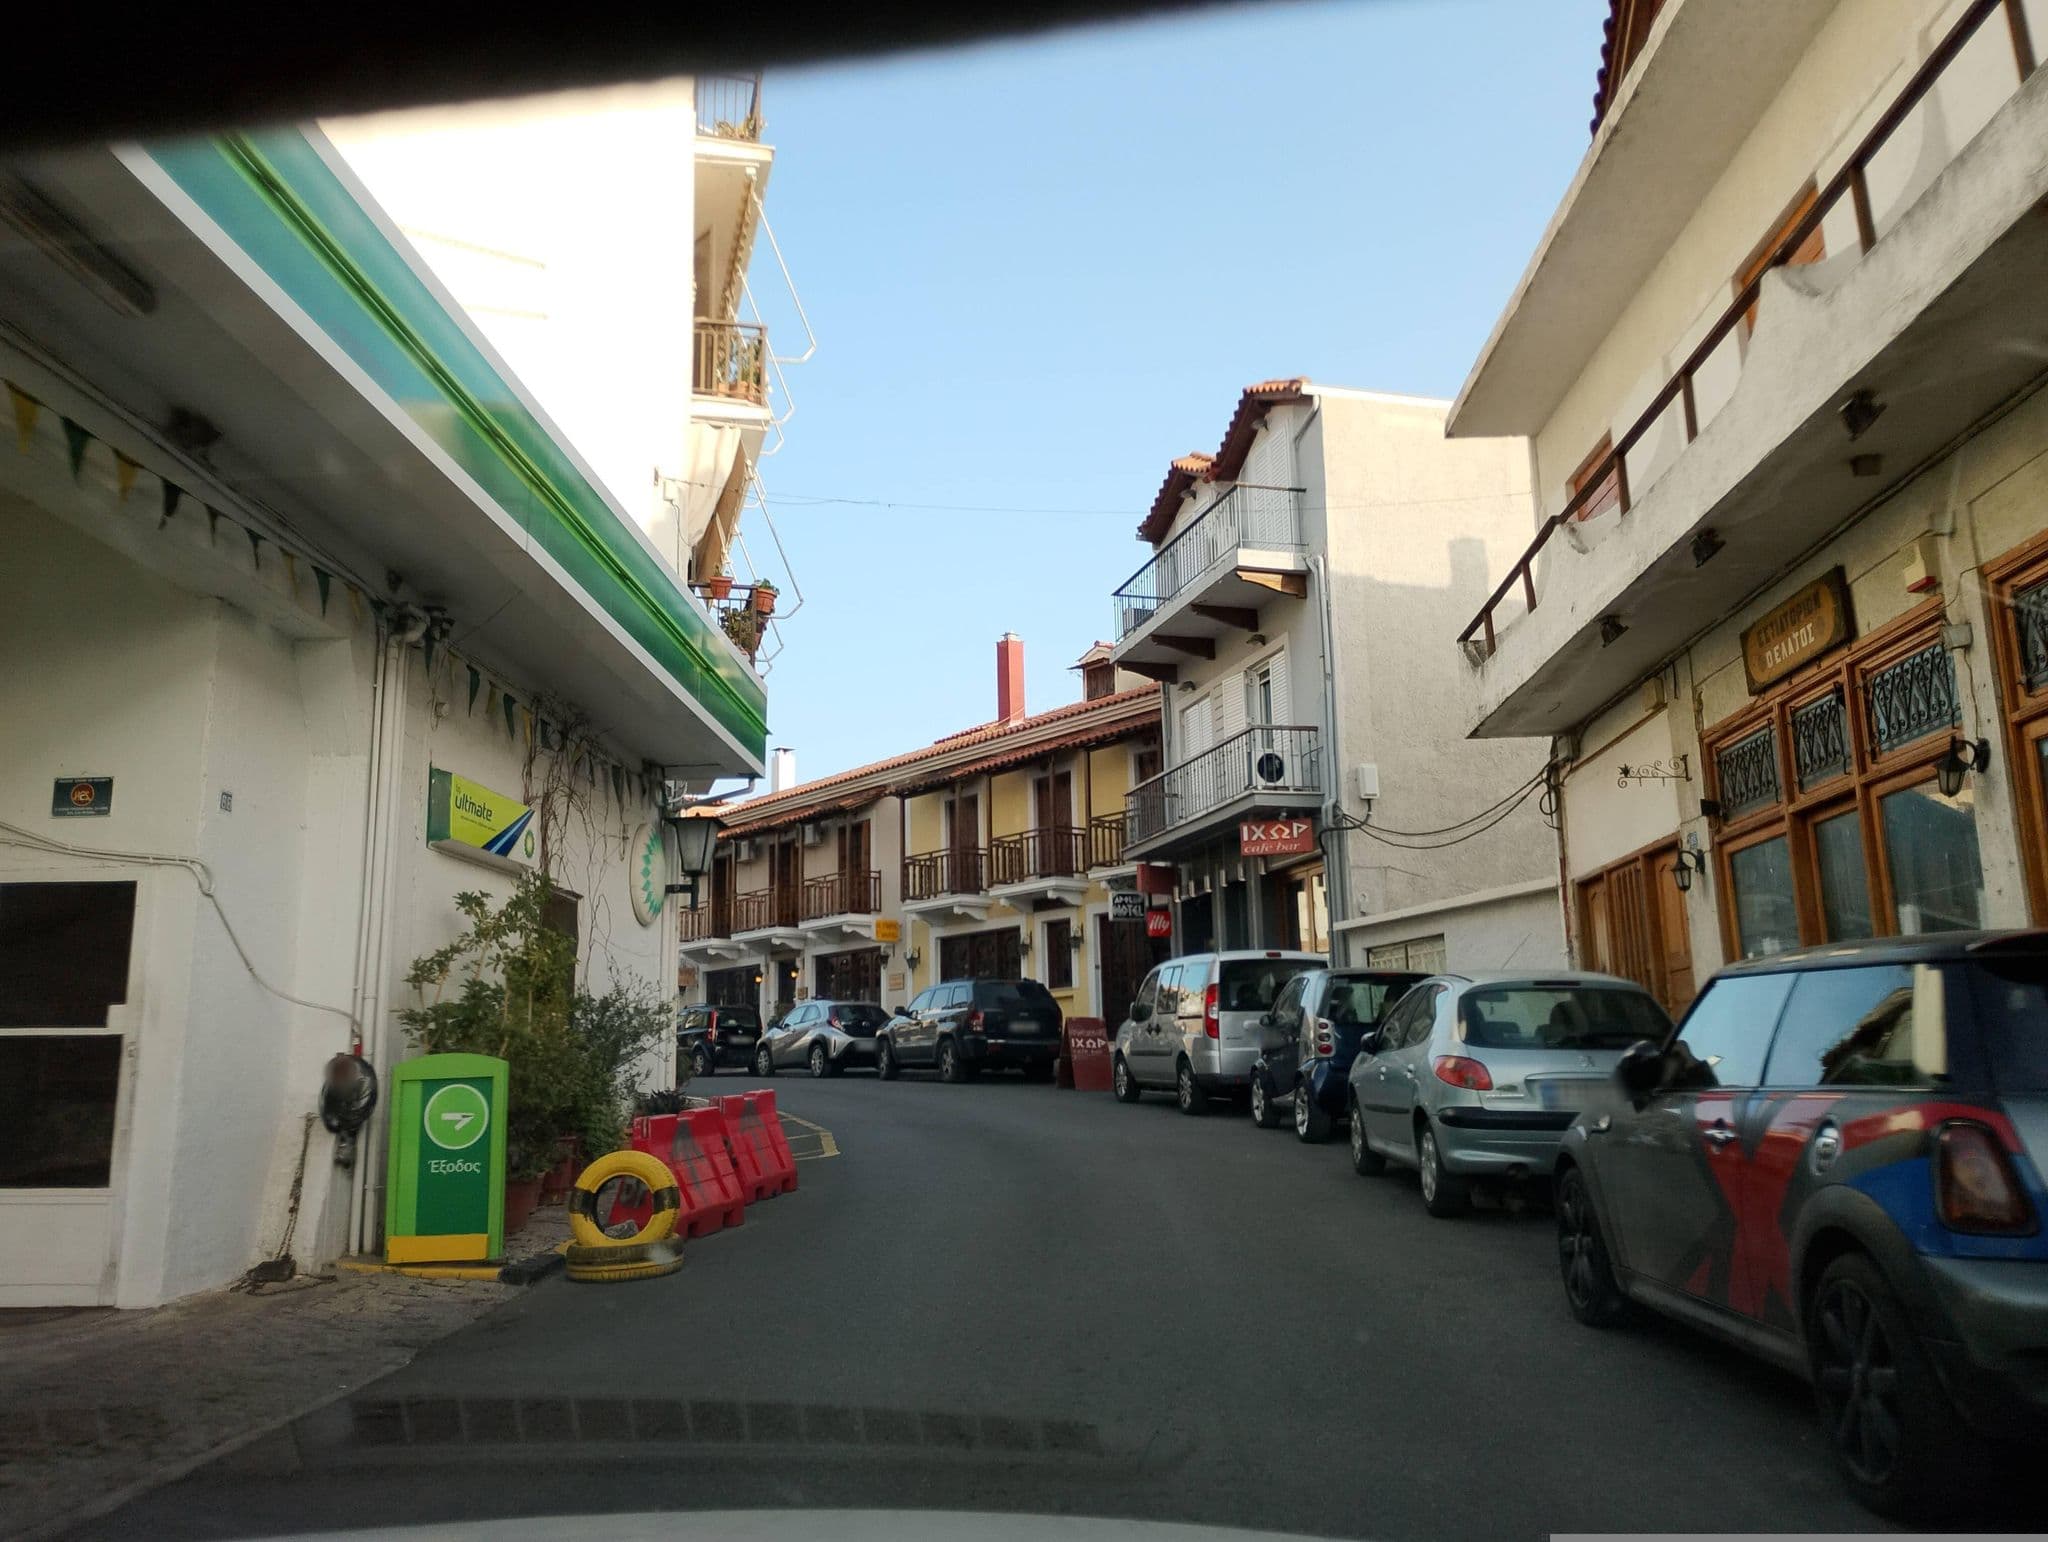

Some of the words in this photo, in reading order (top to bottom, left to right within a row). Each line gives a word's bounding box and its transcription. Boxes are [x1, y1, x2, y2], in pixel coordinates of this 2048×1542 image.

[1276, 842, 1300, 851] bar
[1149, 914, 1170, 934] illy
[427, 1158, 481, 1175] Έξοδος
